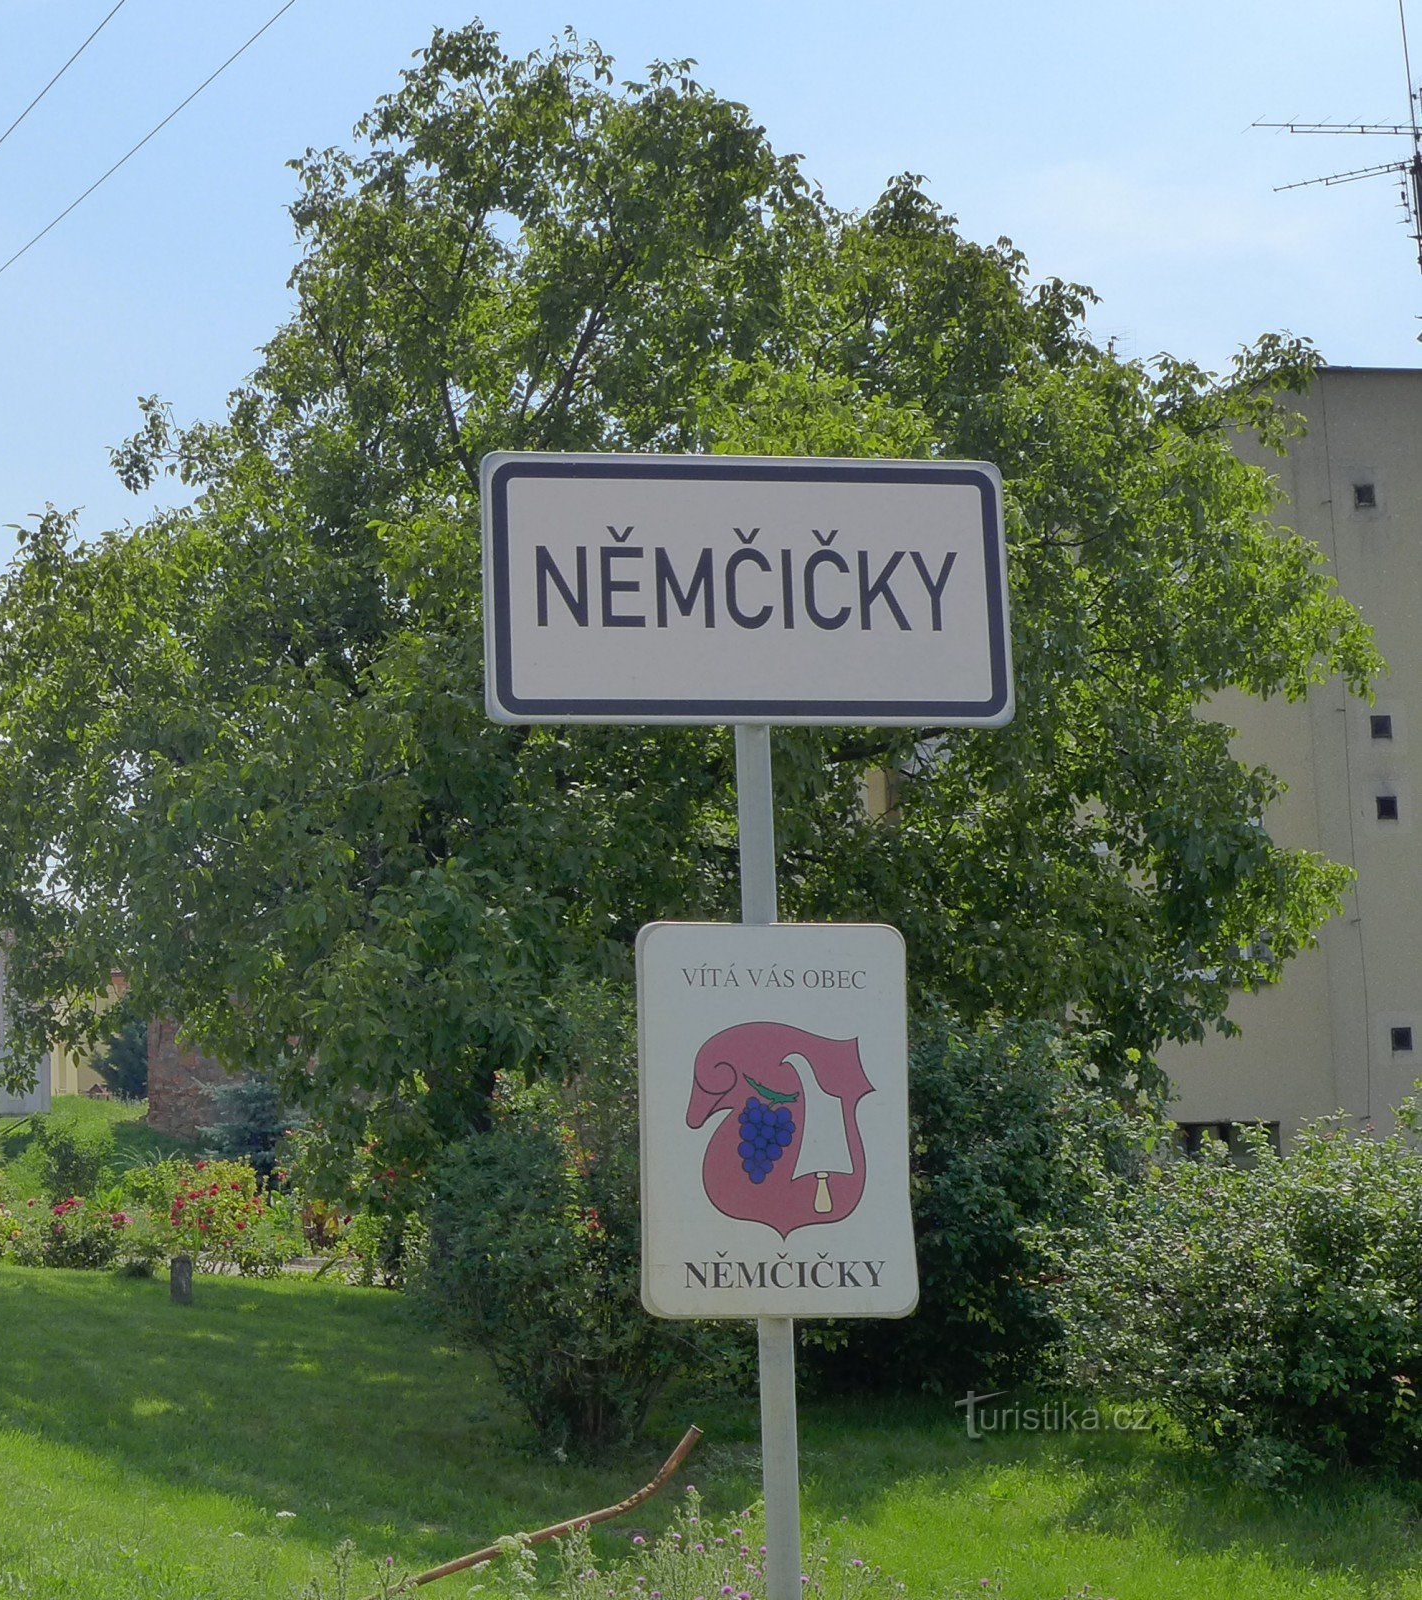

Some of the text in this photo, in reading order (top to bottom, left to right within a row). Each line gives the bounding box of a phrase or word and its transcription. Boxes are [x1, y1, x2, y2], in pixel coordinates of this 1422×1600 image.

[534, 525, 958, 632] NĚMČIČKY
[681, 962, 867, 990] VÍTÁ VÁS OBEC
[683, 1250, 886, 1289] NĚMČIČKY
